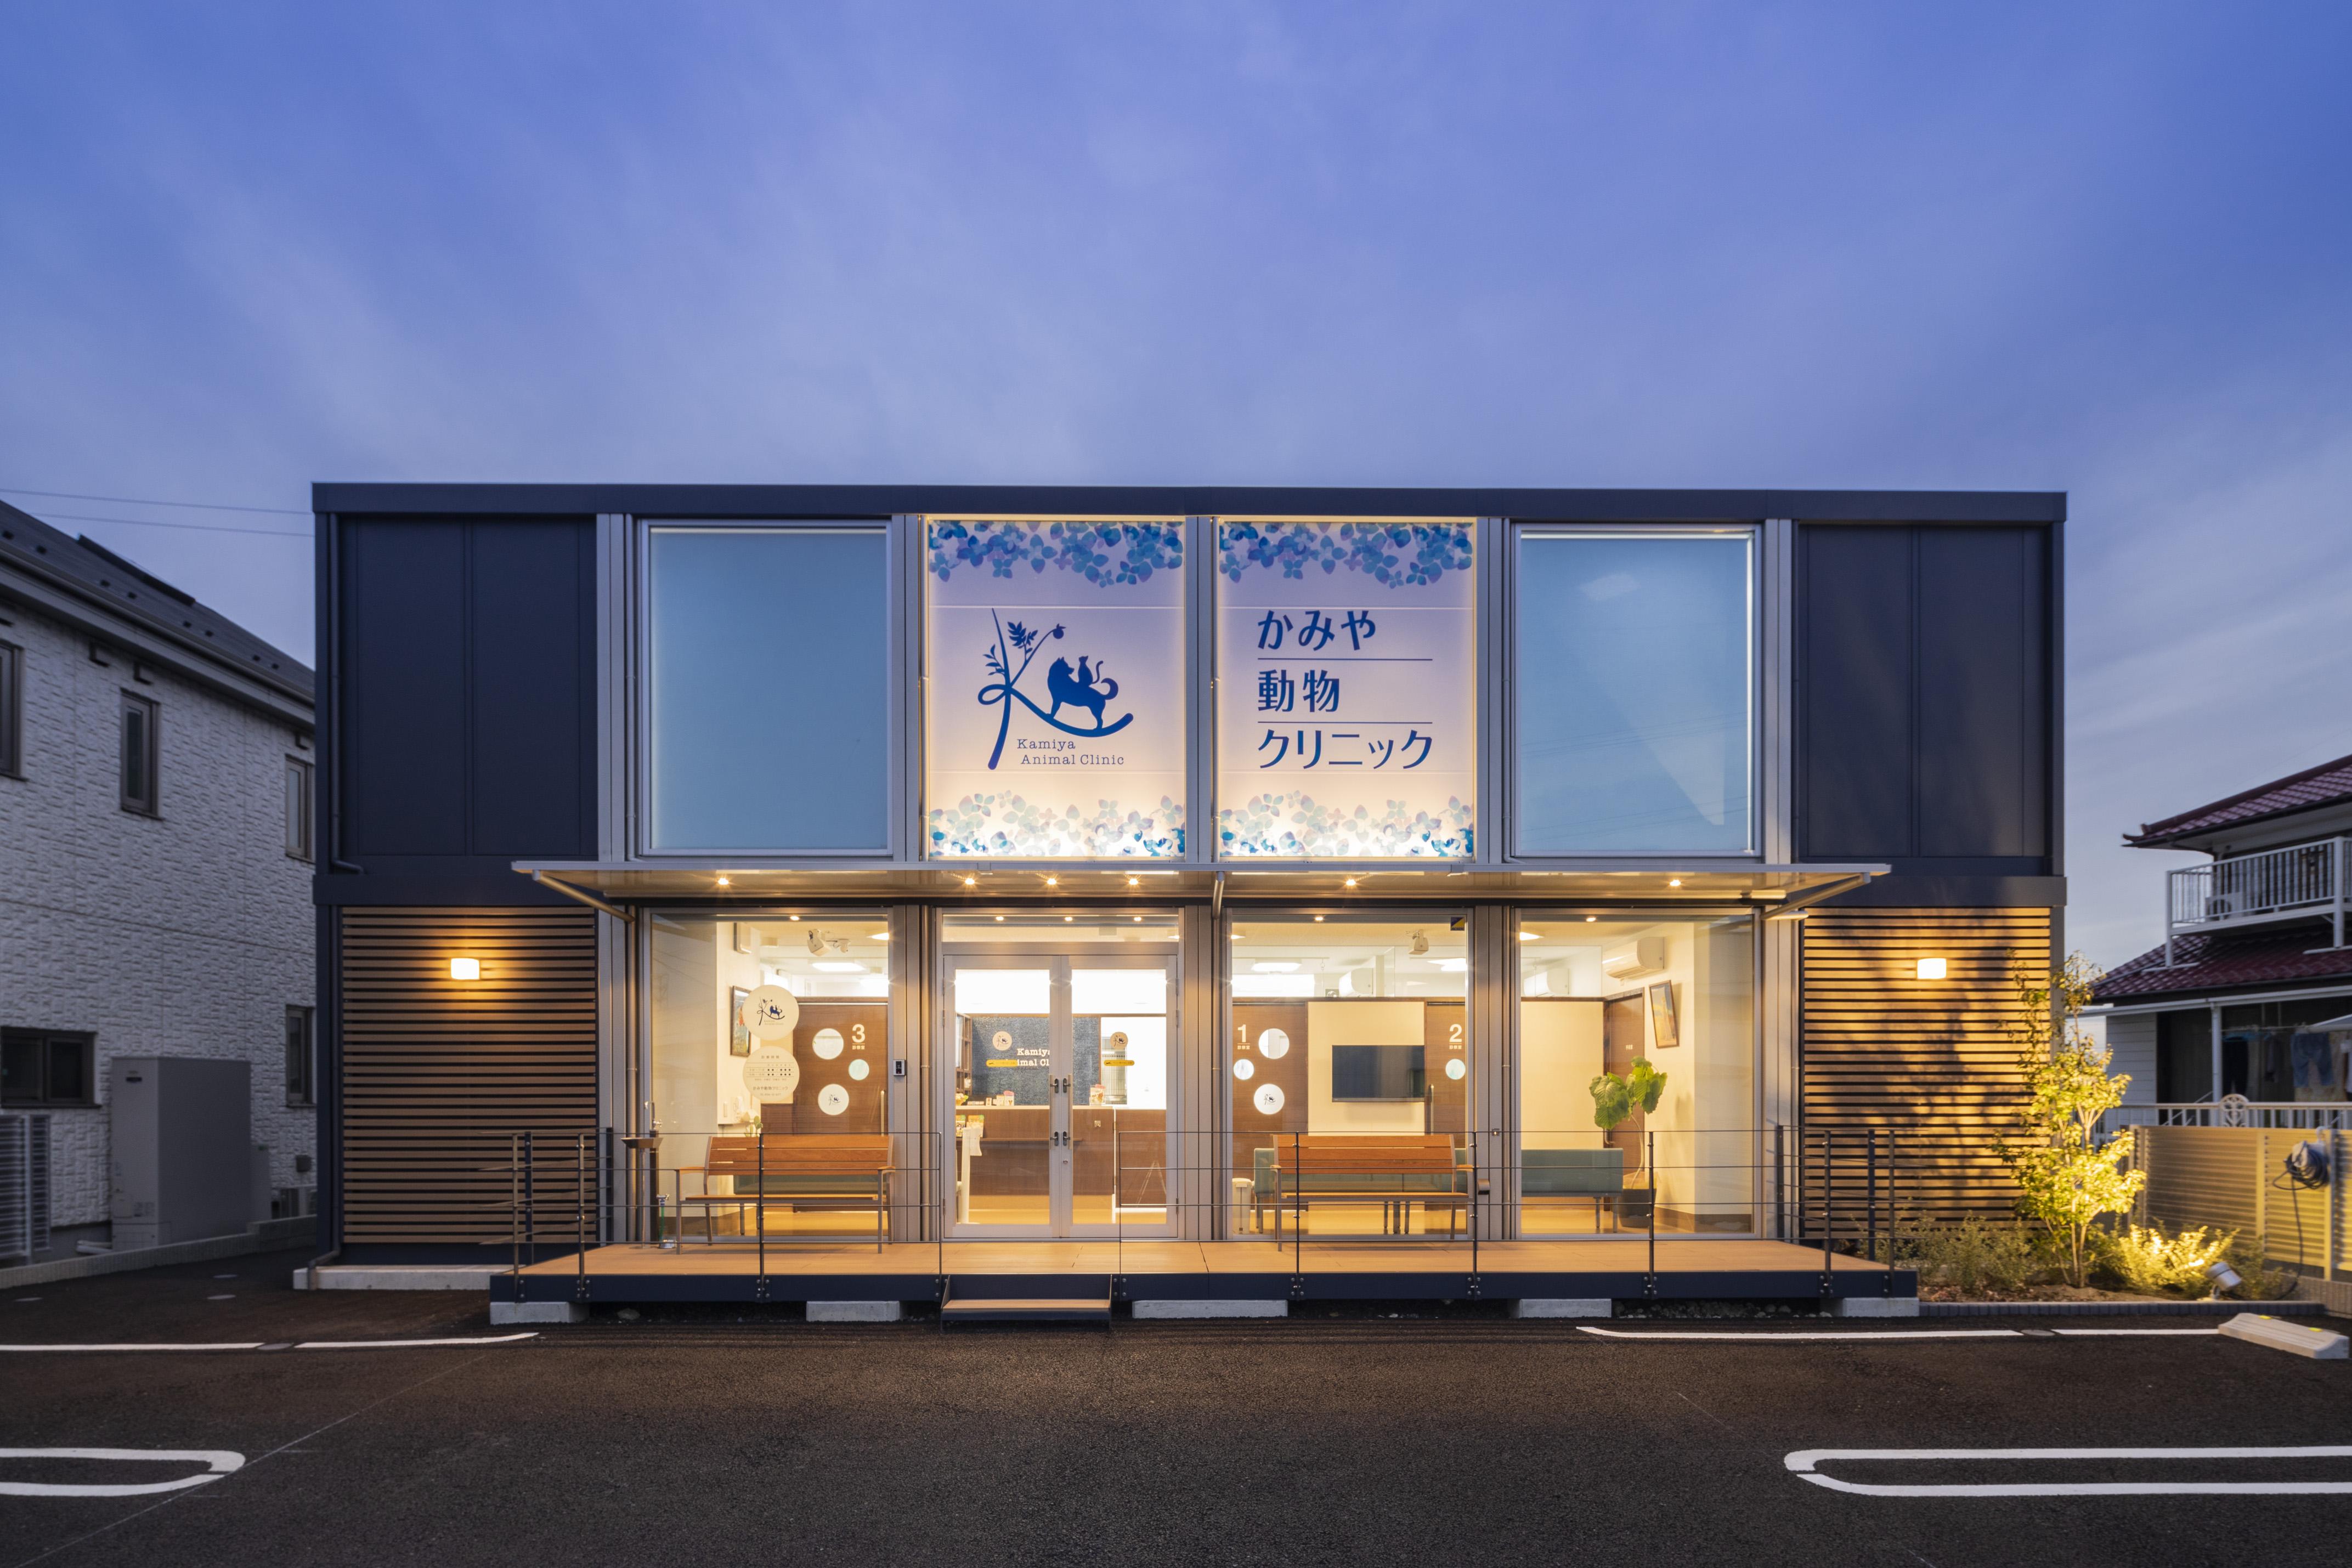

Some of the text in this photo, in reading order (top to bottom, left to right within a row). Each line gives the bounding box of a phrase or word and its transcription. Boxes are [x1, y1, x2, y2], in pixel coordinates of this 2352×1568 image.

[1258, 610, 1376, 651] かみや
[1258, 669, 1339, 712] 動物
[1017, 739, 1076, 751] Kamiya
[1258, 729, 1432, 769] クリニック
[1021, 754, 1124, 765] Animal Clinic
[852, 1024, 865, 1043] 3
[1237, 1024, 1246, 1043] 1
[1449, 1024, 1462, 1043] 2
